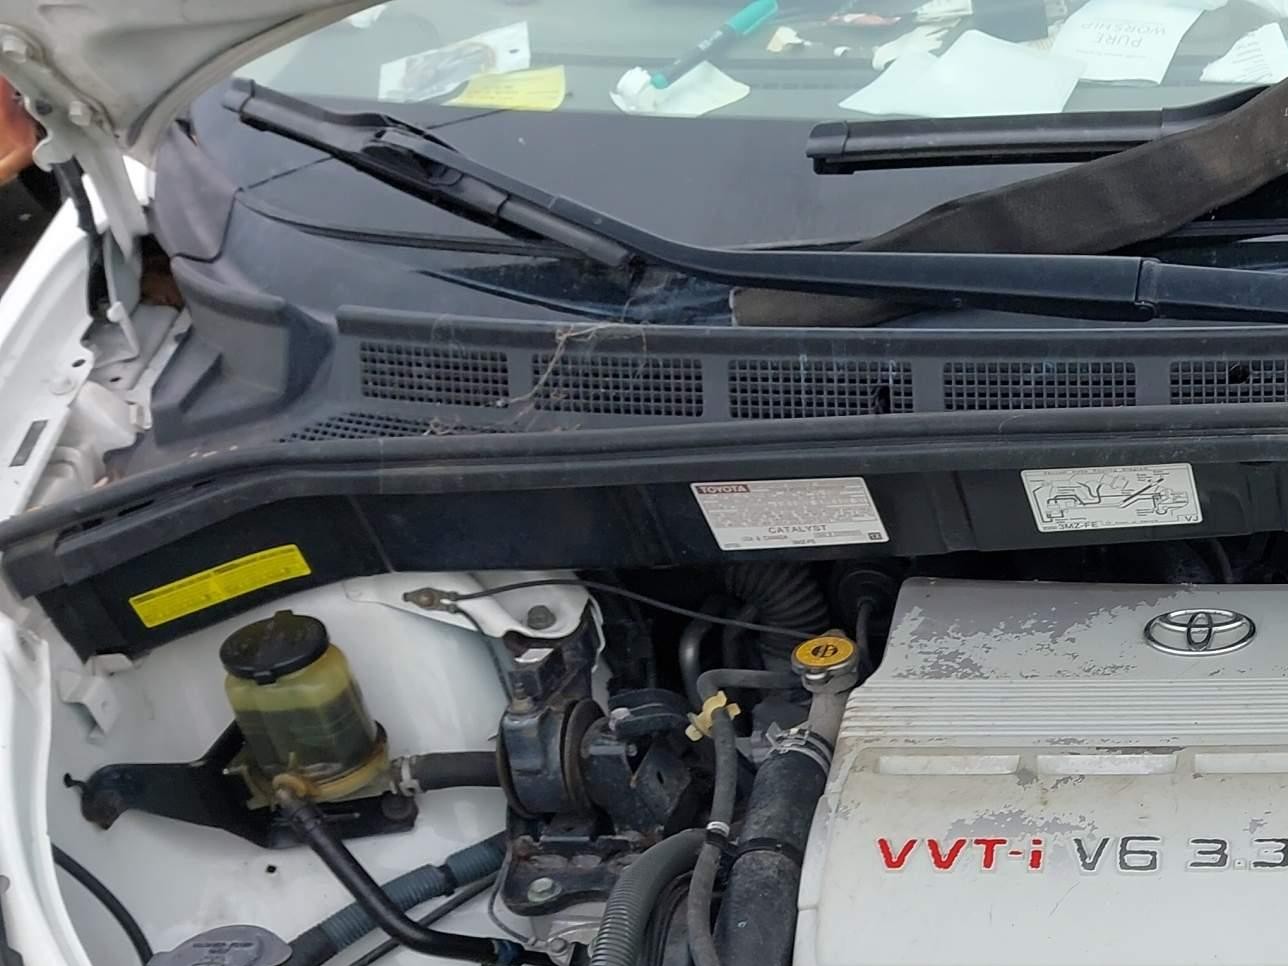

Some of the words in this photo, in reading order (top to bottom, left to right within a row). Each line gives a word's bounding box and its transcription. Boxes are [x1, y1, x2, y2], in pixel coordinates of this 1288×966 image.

[1080, 22, 1166, 36] WORSHIP
[1094, 32, 1144, 48] PURE
[698, 484, 748, 494] TOYOTA
[768, 524, 827, 534] CATALYST
[876, 837, 1043, 870] VVT-i
[1072, 836, 1161, 871] V6
